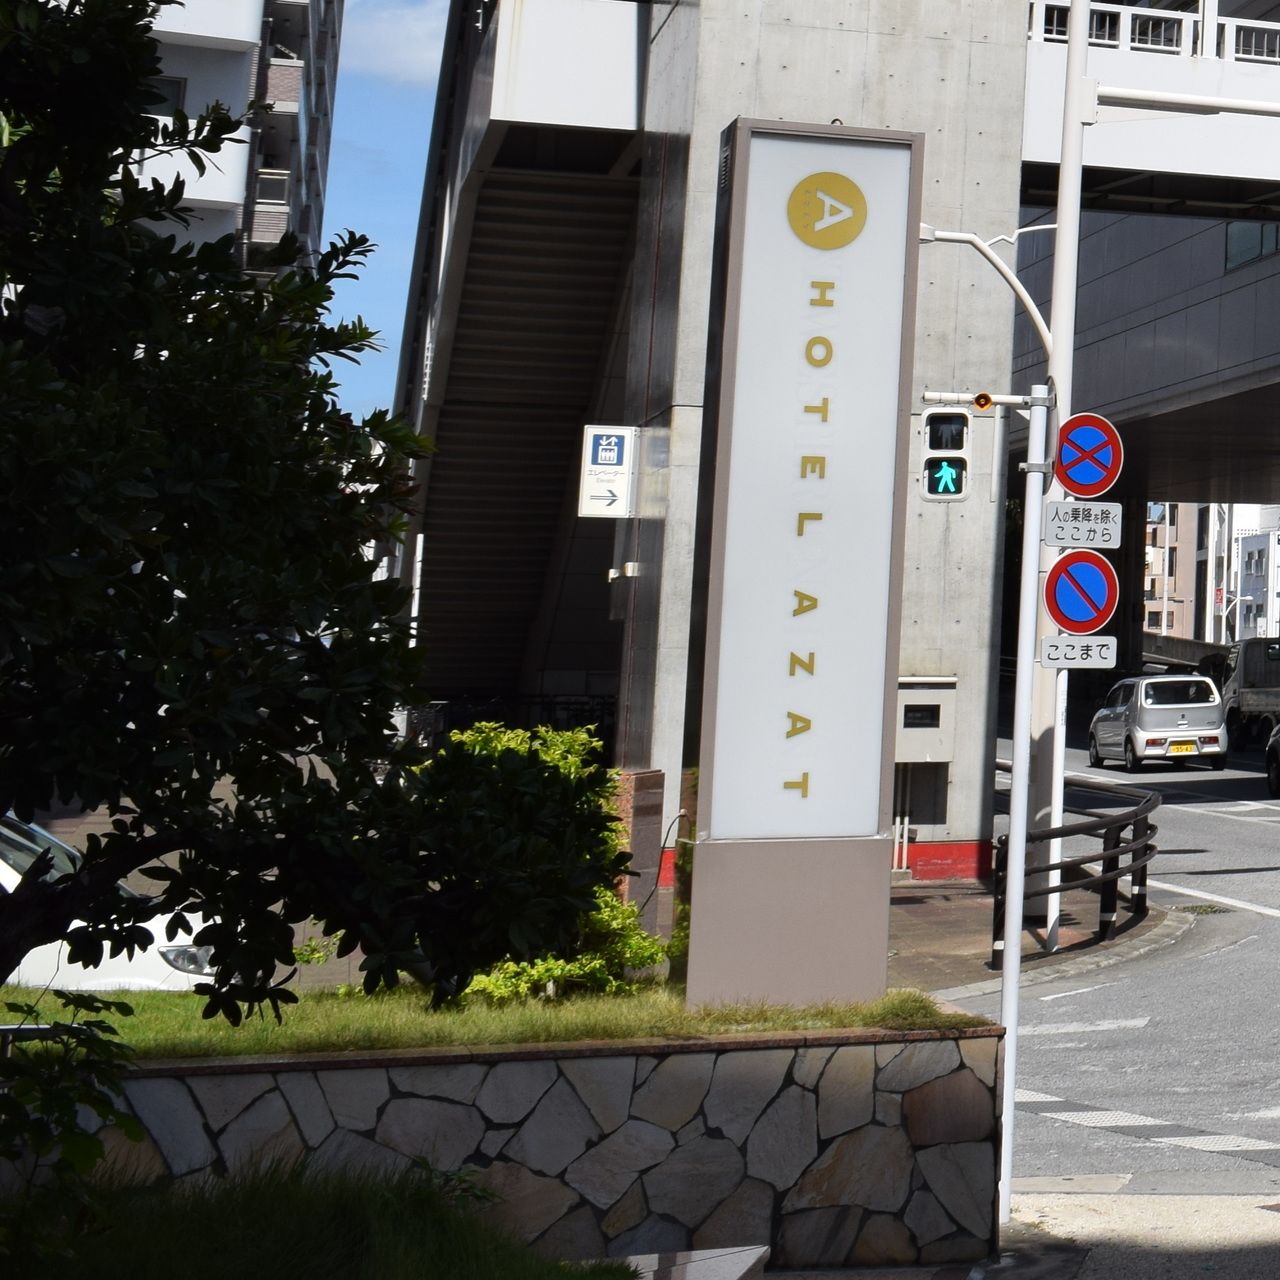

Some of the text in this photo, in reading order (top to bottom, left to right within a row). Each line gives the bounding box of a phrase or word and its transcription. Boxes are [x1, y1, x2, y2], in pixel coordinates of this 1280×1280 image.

[1051, 507, 1119, 525] 人の乗降を除く
[783, 281, 836, 798] HOTEL AZAT
[1055, 525, 1112, 543] ここから
[1047, 643, 1111, 662] ここまで
